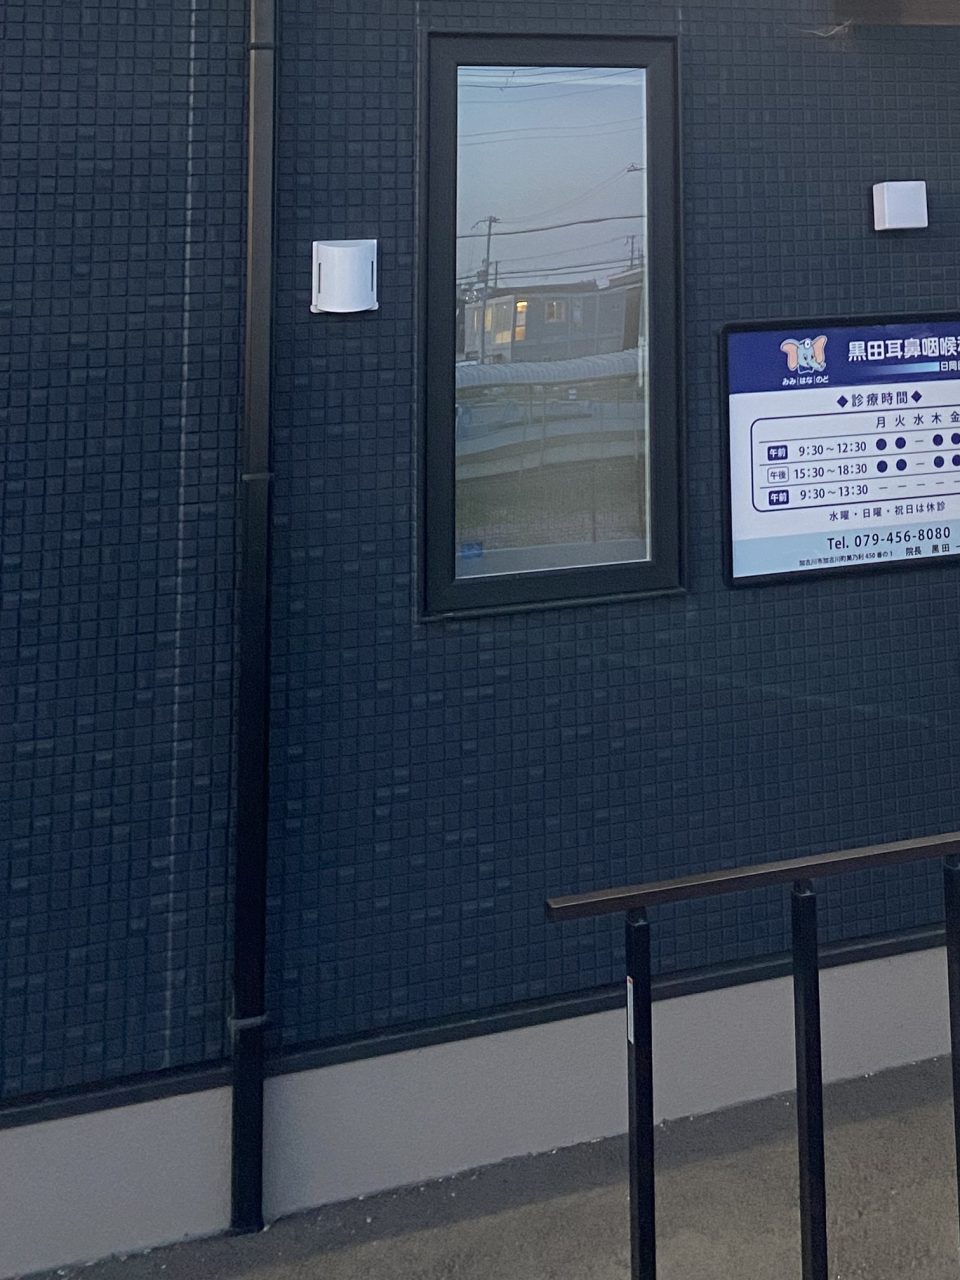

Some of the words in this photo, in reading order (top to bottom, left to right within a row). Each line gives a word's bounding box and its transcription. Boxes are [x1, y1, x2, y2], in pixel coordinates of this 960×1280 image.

[851, 391, 908, 407] 診療時間
[876, 416, 886, 428] 月
[895, 415, 906, 426] 火
[913, 413, 924, 425] 水
[931, 412, 942, 424] 木
[950, 410, 960, 423] 金
[769, 447, 787, 458] 午前
[770, 470, 787, 480] 午後
[770, 492, 787, 503] 午前
[827, 538, 849, 550] Tel.
[854, 527, 951, 547] 079-456-8080
[905, 546, 921, 556] 院長
[932, 544, 950, 553] 黒田
